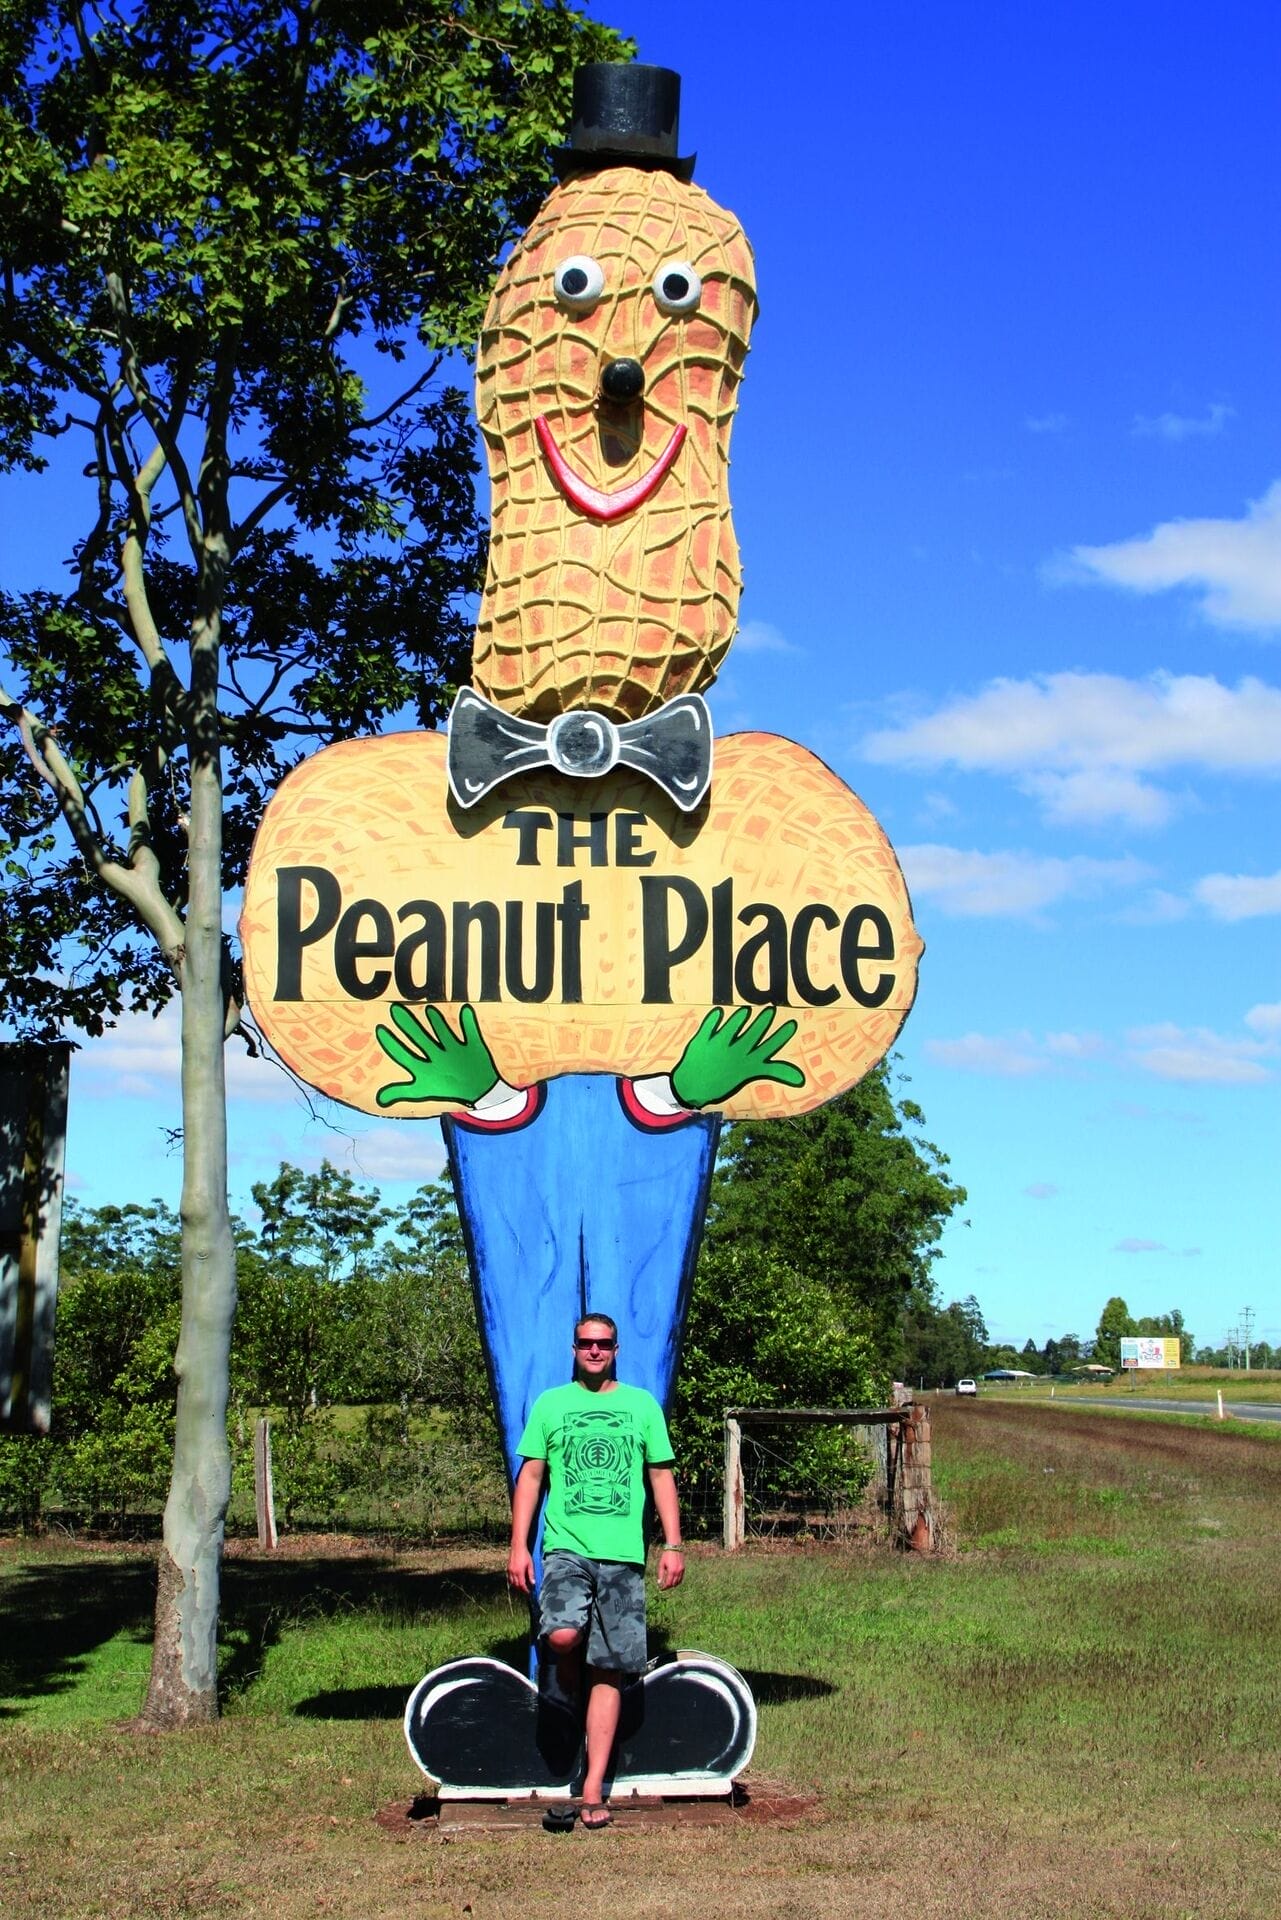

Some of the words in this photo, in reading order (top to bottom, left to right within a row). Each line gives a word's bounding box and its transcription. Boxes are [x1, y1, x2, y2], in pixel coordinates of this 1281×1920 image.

[503, 811, 657, 867] THE
[273, 866, 589, 1004] Peanut
[640, 875, 896, 1008] Place
